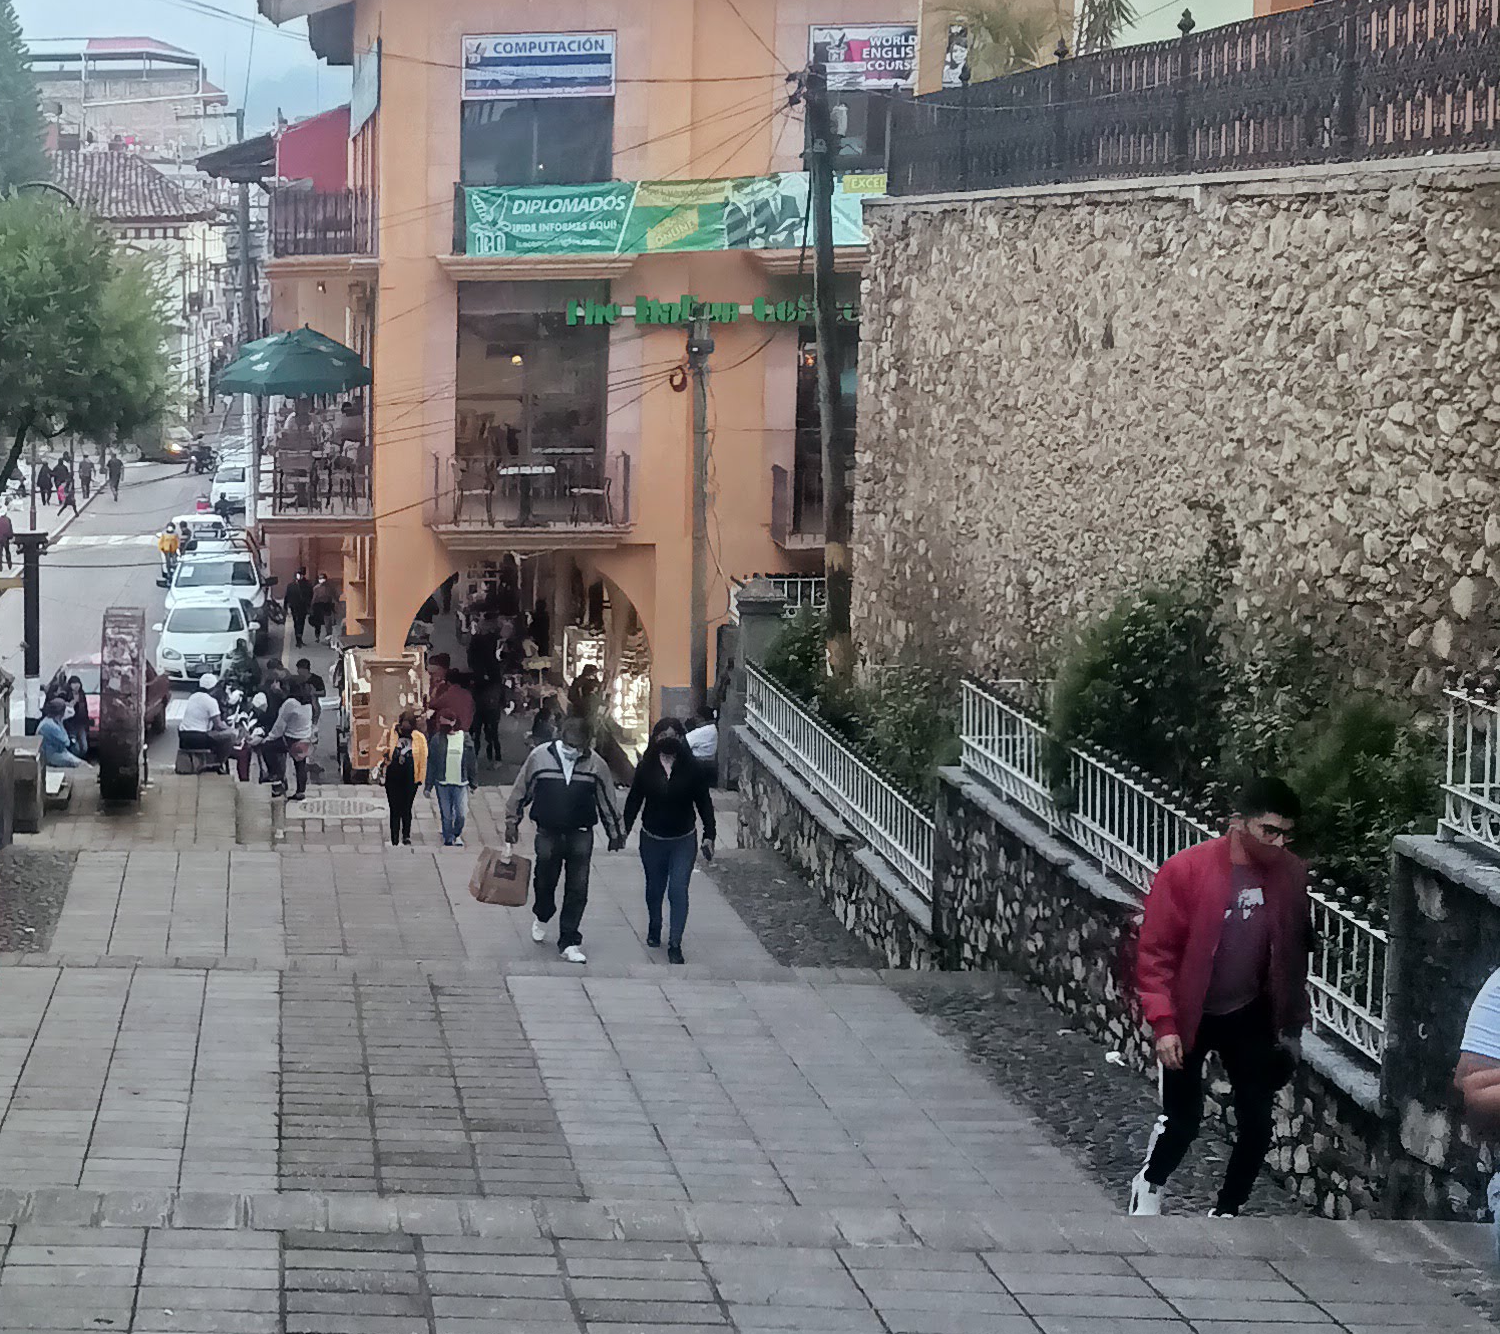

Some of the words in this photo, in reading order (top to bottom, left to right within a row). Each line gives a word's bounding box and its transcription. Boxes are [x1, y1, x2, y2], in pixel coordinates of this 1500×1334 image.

[493, 38, 605, 54] COMPUTACIÓN
[870, 35, 916, 46] WORLD
[862, 47, 916, 59] ENGLIS
[512, 195, 627, 215] DIPLOMADOS
